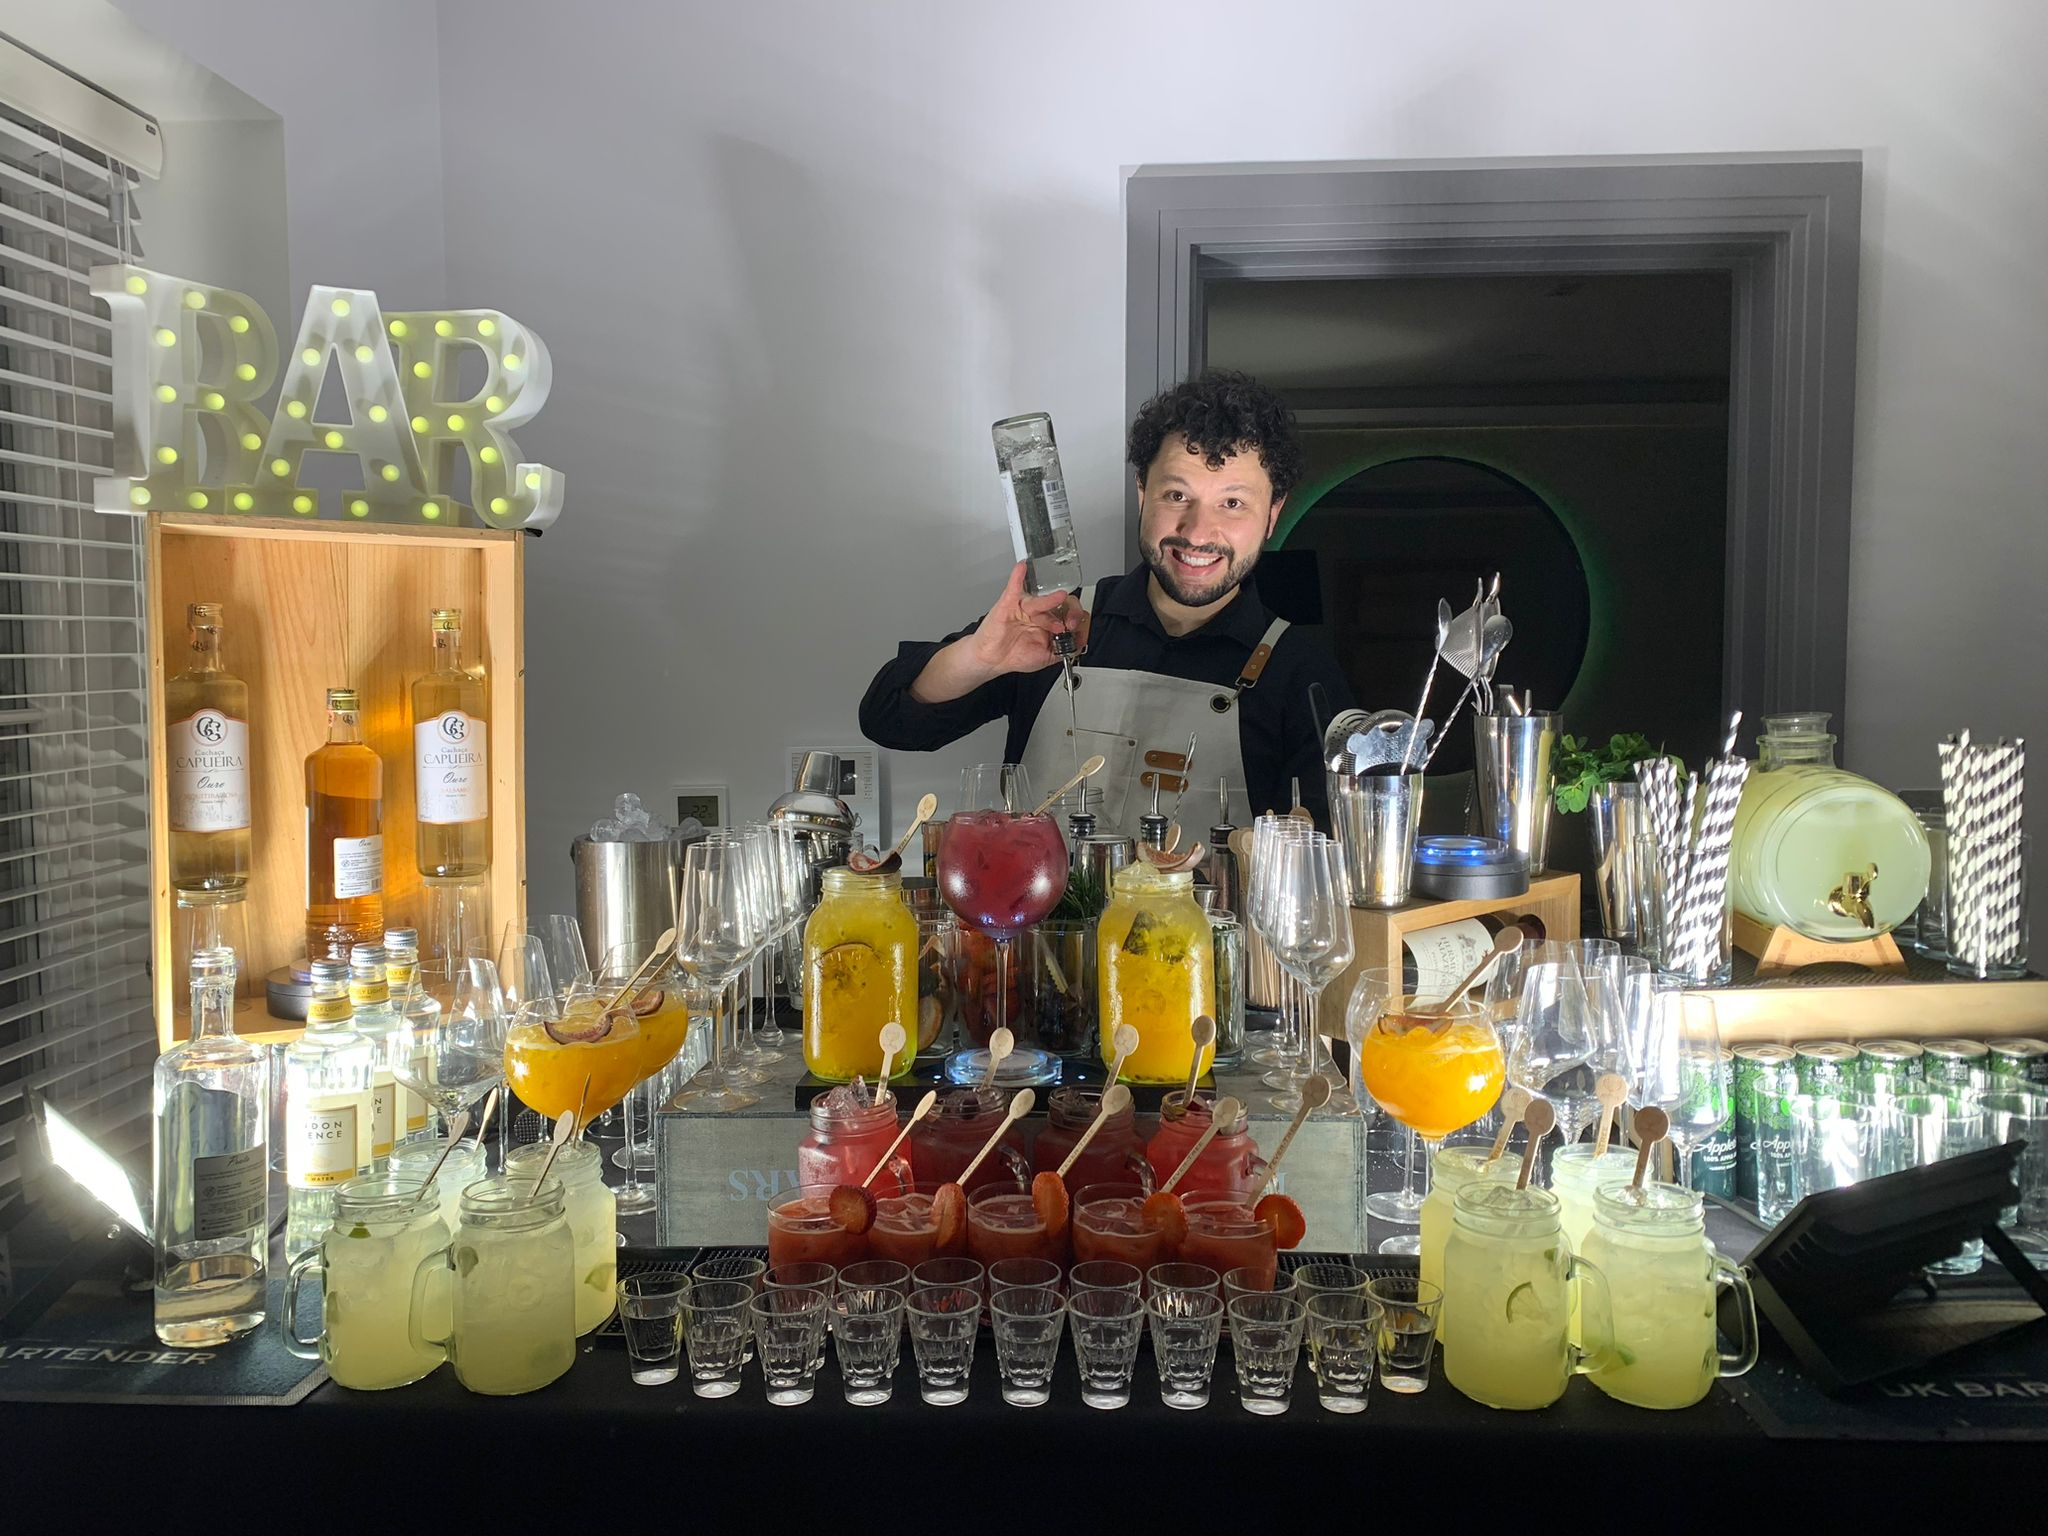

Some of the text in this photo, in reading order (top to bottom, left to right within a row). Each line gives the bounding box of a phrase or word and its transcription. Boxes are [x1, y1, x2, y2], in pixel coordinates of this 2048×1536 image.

[90, 264, 565, 529] BAR
[176, 756, 243, 768] CAPUEIRA
[424, 753, 482, 765] CAPUEIRA
[1954, 1381, 2048, 1397] BAR
